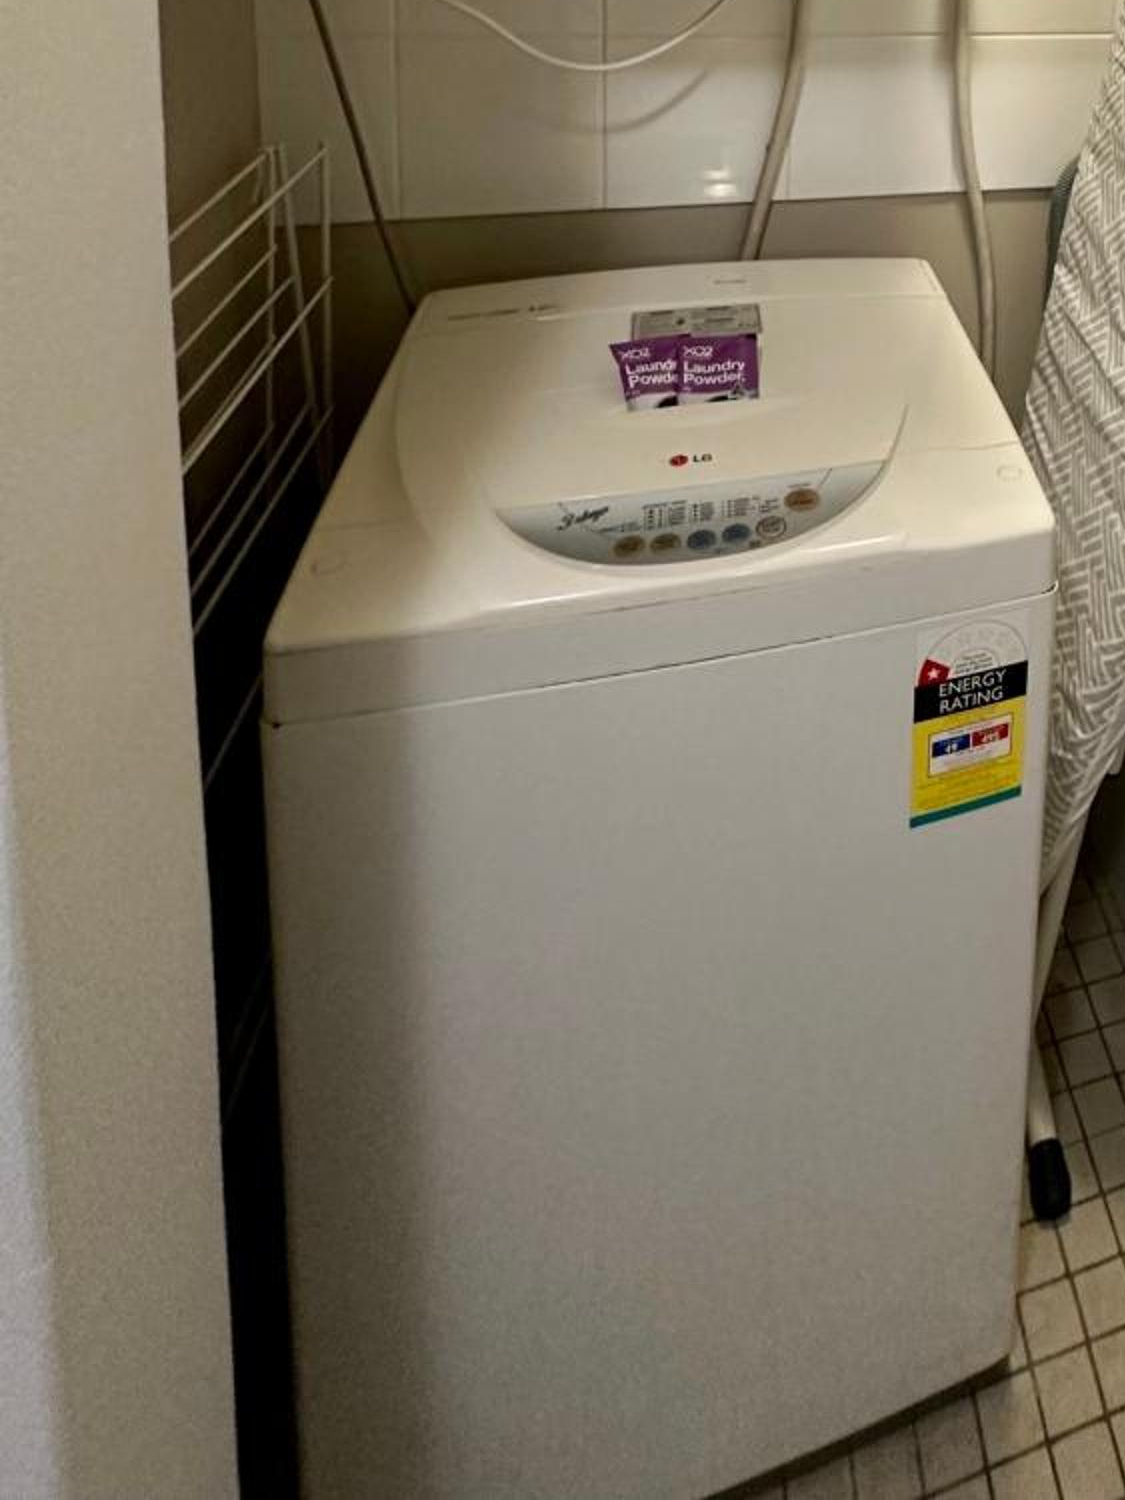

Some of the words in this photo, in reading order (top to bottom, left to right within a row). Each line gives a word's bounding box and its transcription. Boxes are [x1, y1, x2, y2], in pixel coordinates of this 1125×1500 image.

[683, 360, 745, 374] Laundry
[692, 453, 713, 463] LG
[939, 669, 1007, 697] ENERGY
[939, 687, 1004, 714] RATING
